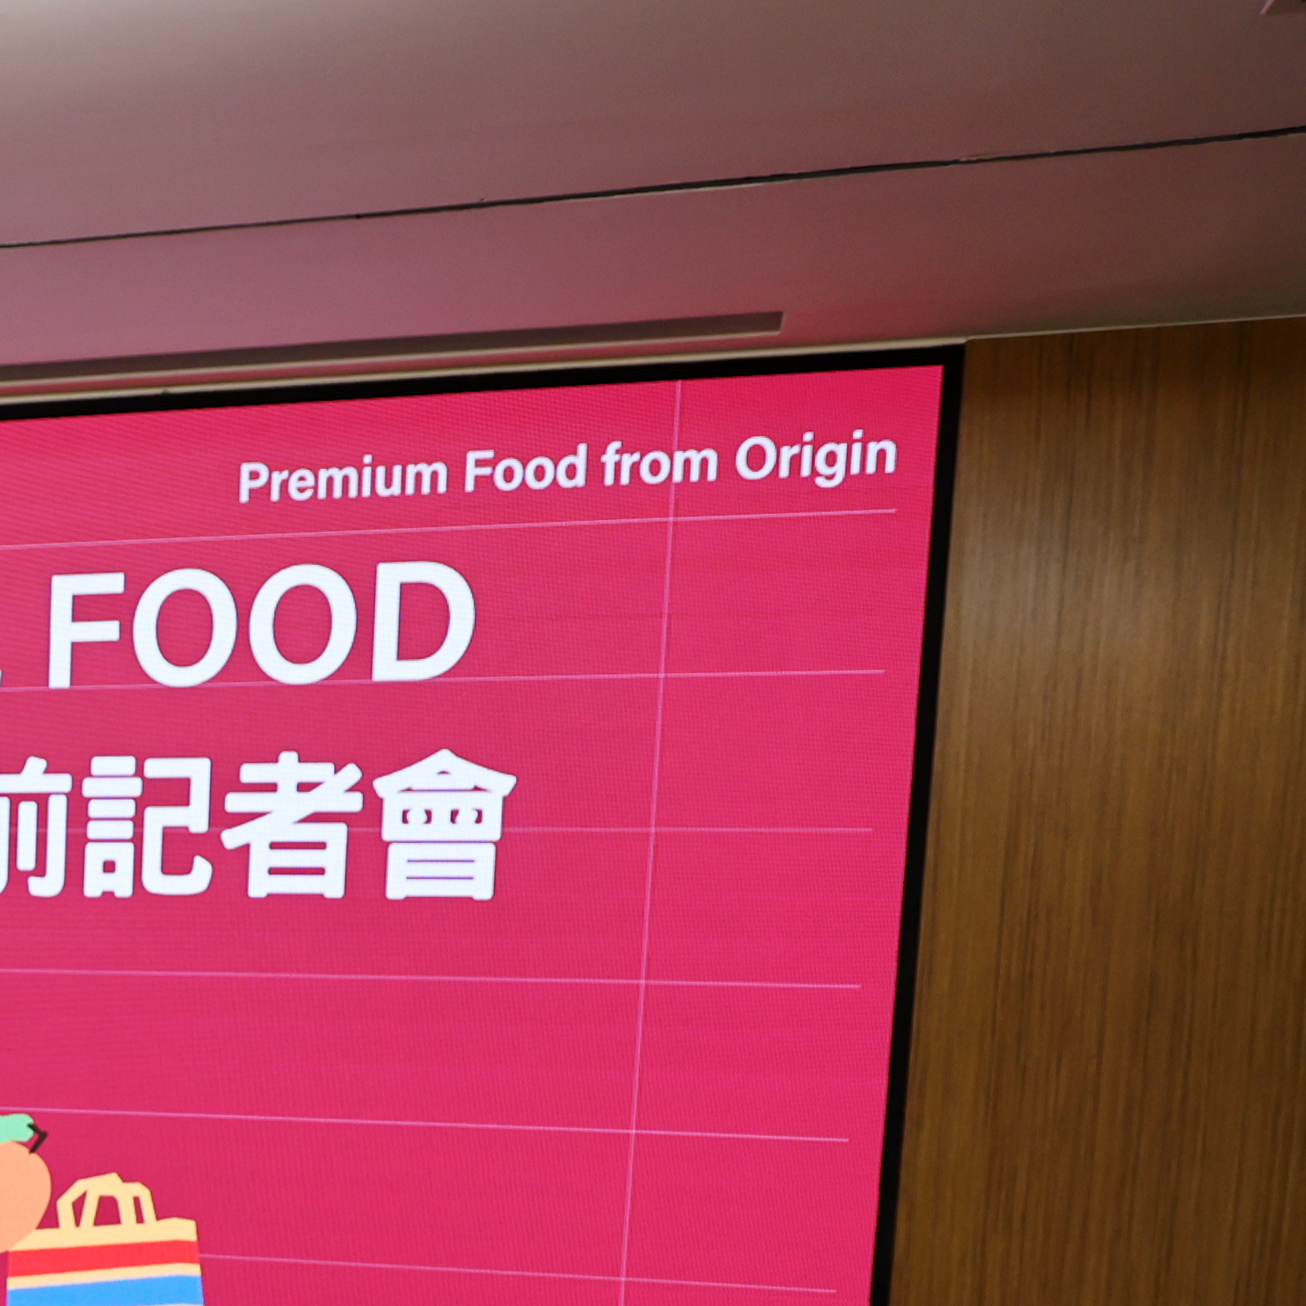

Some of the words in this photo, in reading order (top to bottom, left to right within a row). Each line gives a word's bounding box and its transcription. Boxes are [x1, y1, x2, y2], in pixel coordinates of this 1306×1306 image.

[239, 455, 448, 503] Premium
[465, 443, 586, 491] Food
[601, 441, 717, 487] from
[735, 429, 898, 488] Origin
[47, 560, 476, 689] FOOD
